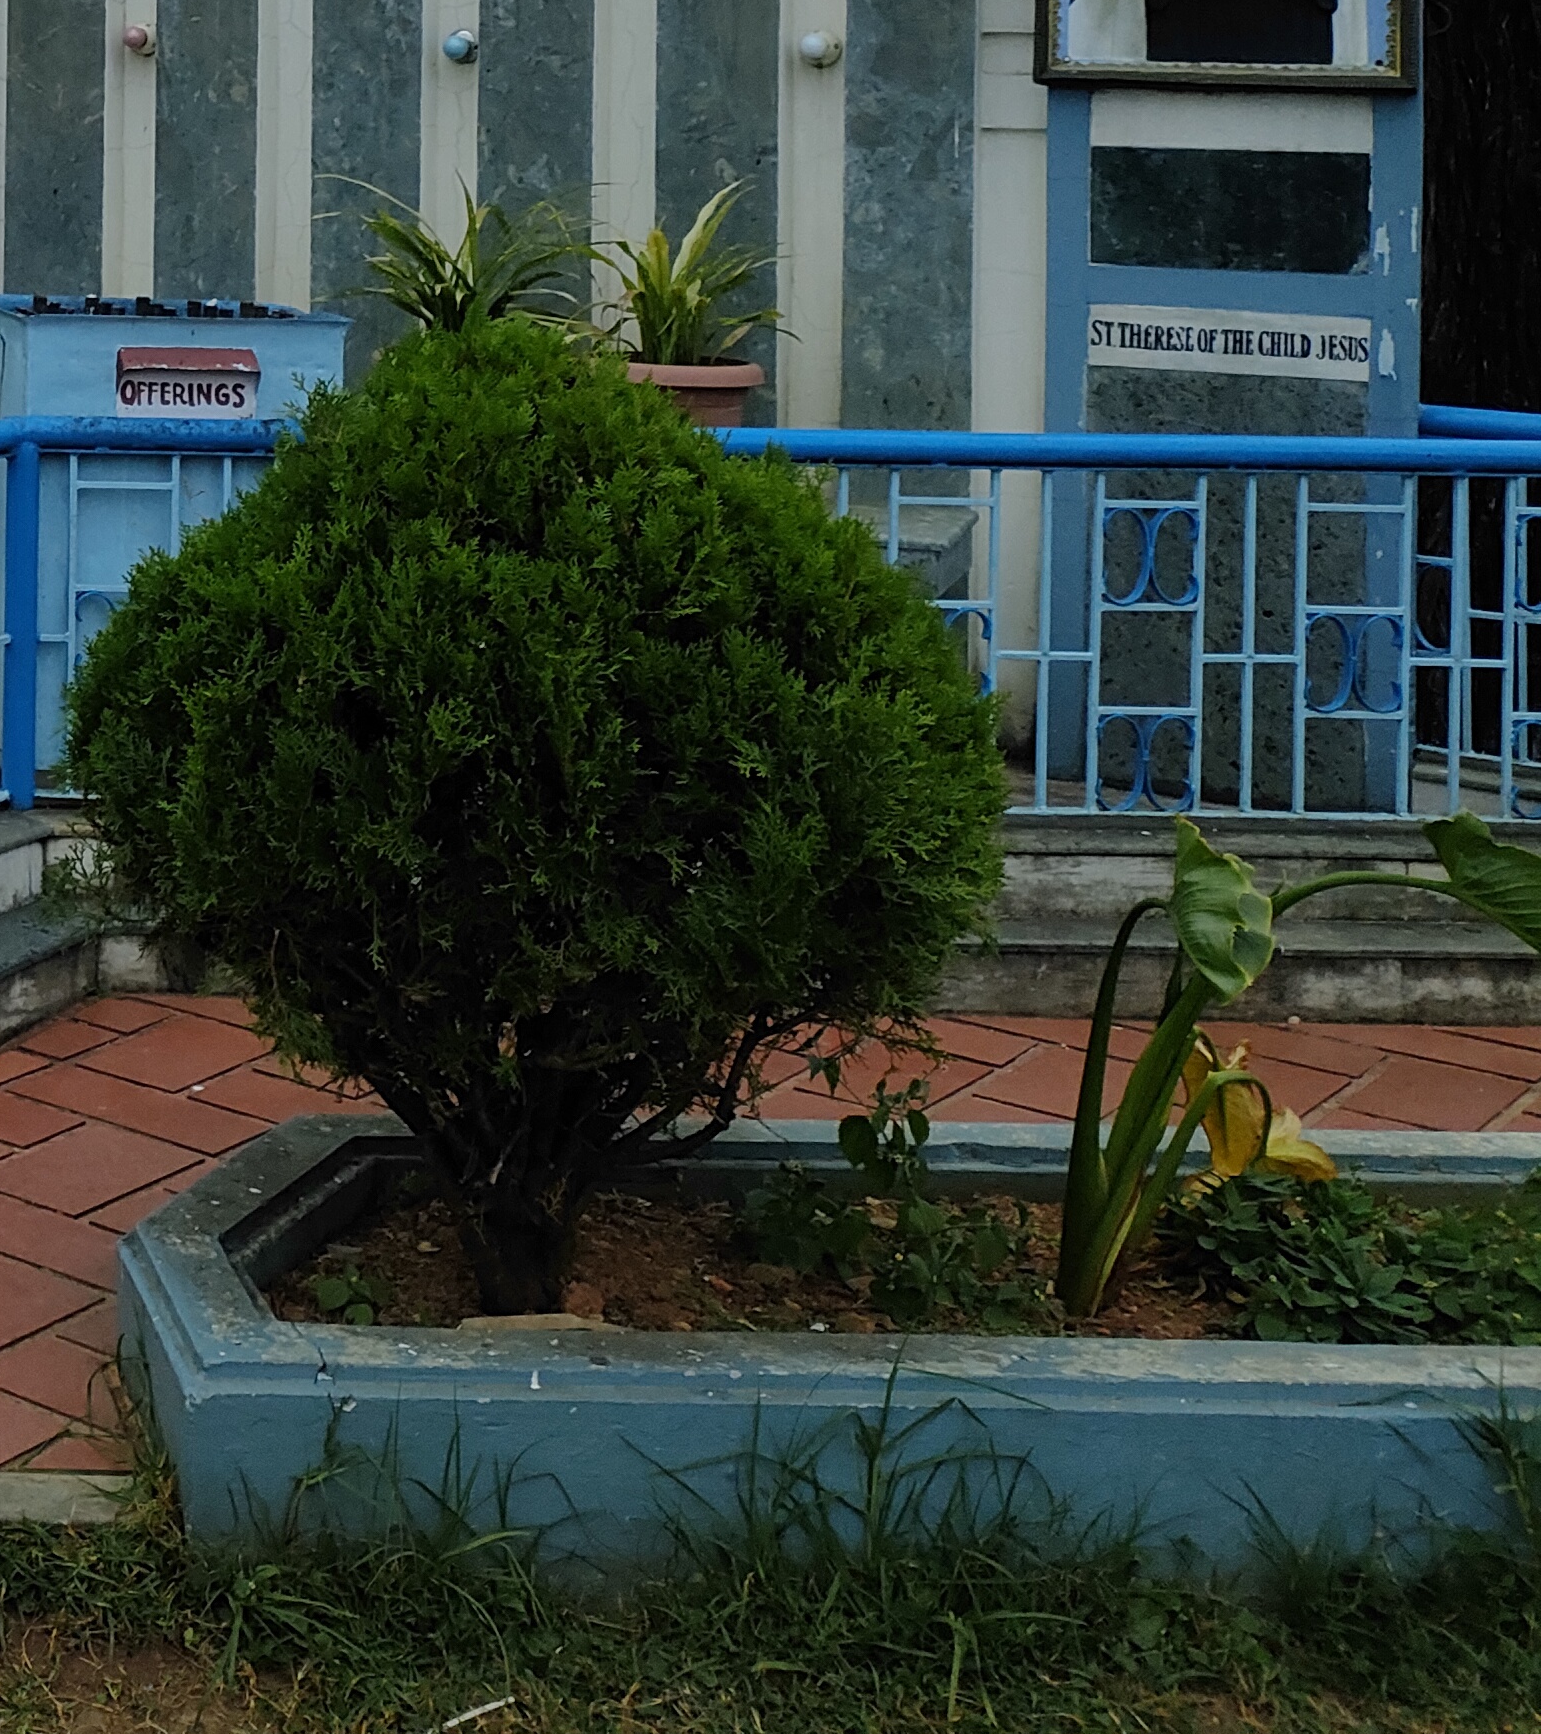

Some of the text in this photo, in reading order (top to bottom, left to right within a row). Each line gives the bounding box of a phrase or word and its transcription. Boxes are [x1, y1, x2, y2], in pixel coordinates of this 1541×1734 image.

[1091, 320, 1369, 363] ST THERESE OF THE CHILD JESUS
[120, 379, 246, 408] OFFERINGS
